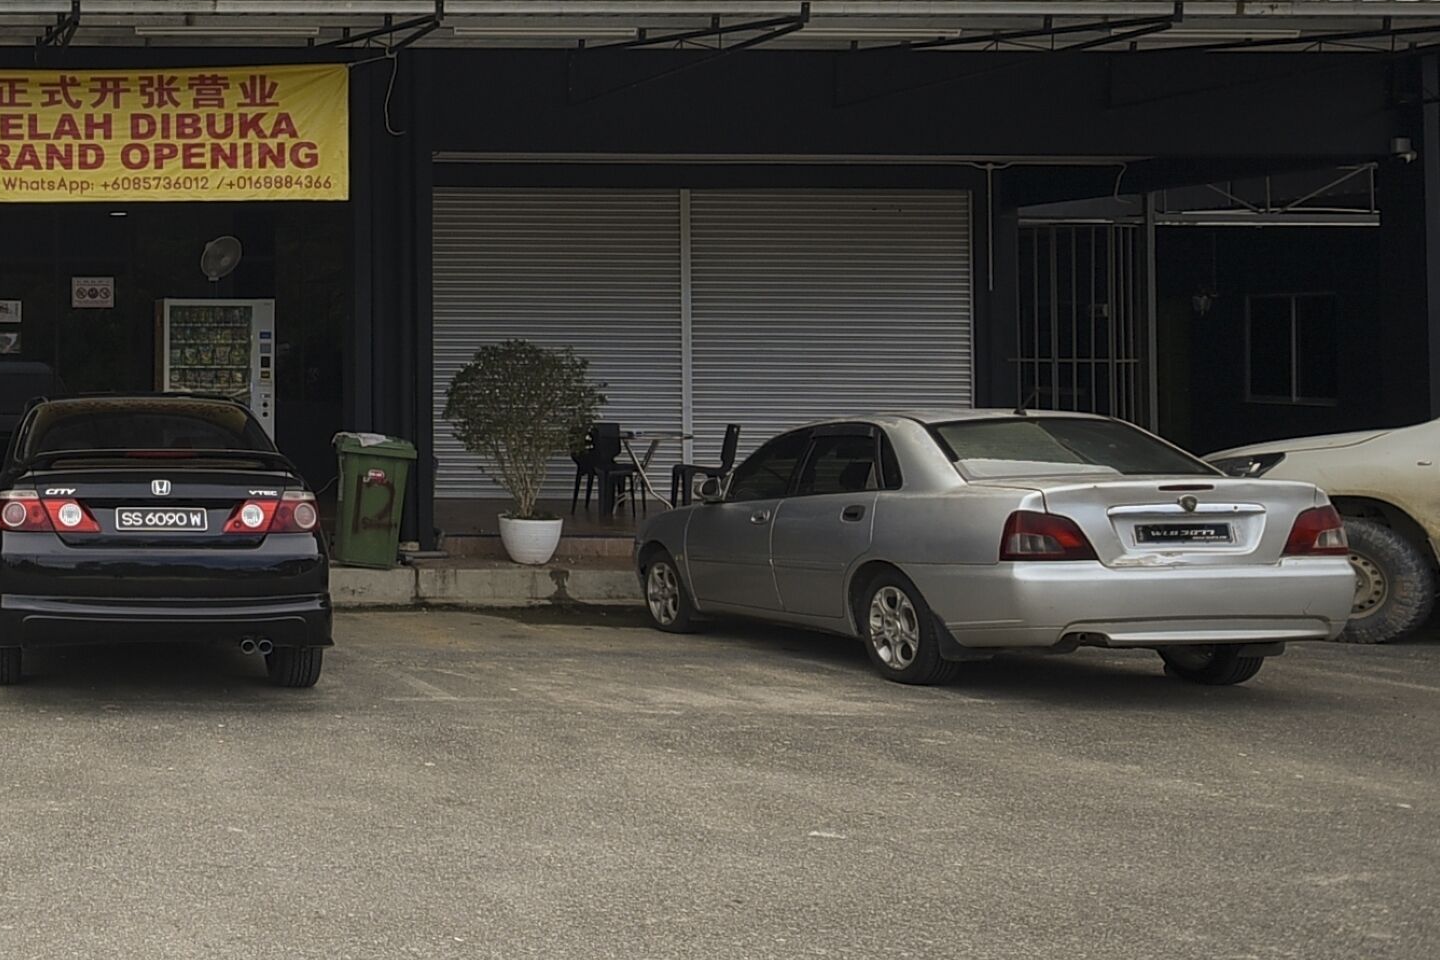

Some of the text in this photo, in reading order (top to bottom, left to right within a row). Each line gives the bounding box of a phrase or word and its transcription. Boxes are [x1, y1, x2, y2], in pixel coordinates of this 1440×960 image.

[131, 112, 299, 140] DIBUKA
[121, 142, 319, 170] OPENING
[2, 177, 94, 194] WhatsApp:
[101, 176, 209, 191] +6085736012
[122, 511, 201, 526] SS 6090 W
